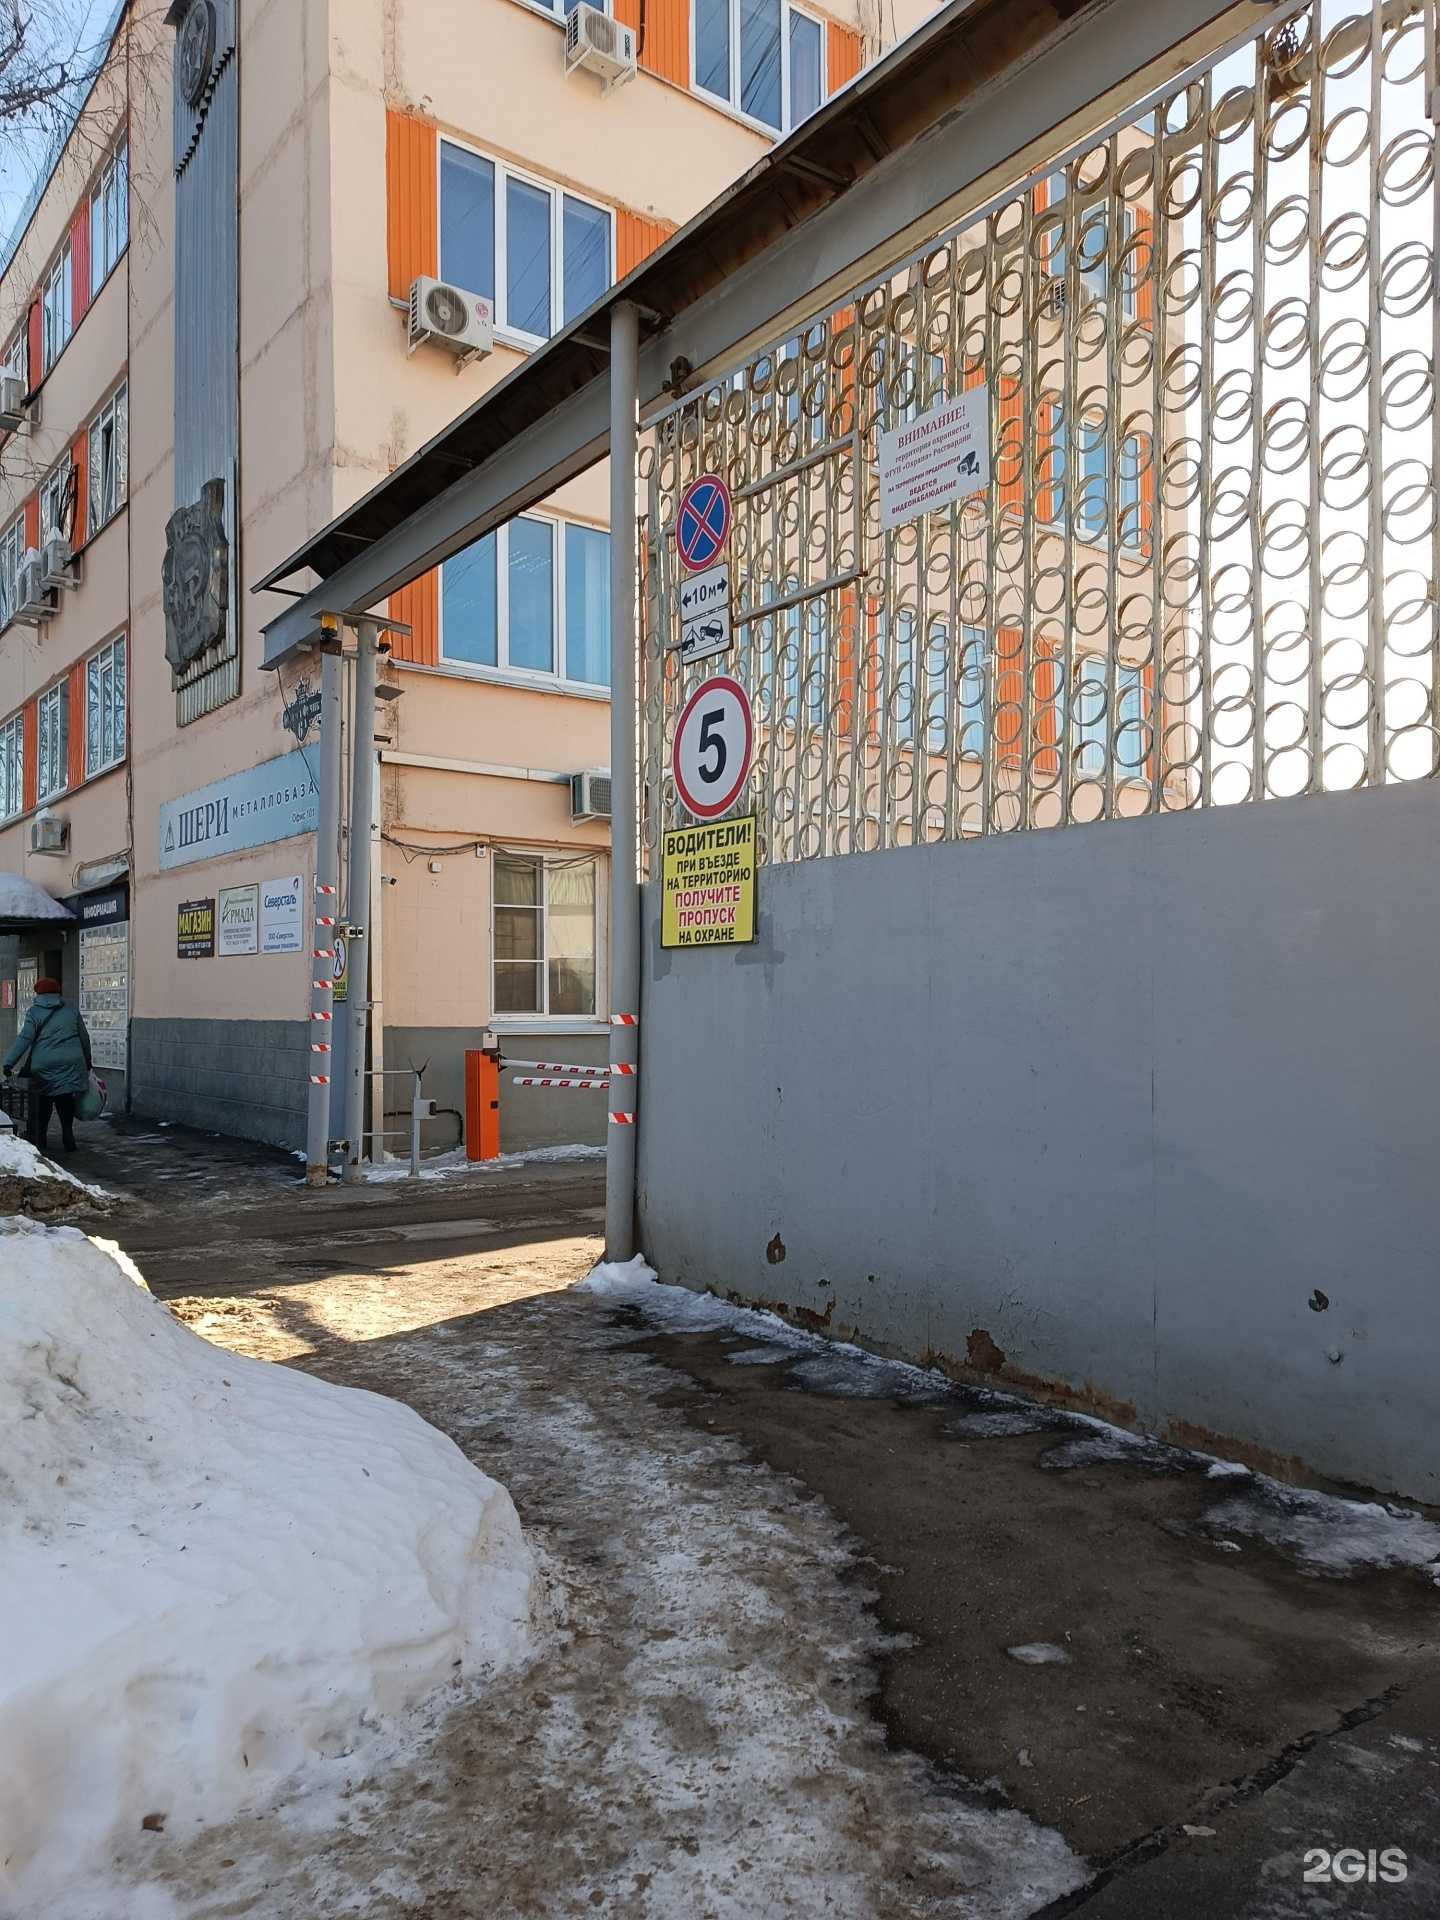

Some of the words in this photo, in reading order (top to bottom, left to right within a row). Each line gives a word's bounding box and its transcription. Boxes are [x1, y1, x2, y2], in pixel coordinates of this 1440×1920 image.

[897, 405, 966, 448] ВНИМАНИЕ!
[932, 422, 970, 446] охраняется
[884, 467, 901, 478] ФГУП
[891, 480, 957, 514] ВИДЕОНАБЛЮДЕНИЕ
[909, 478, 938, 496] ВЕДЕТСЯ
[698, 707, 727, 784] 5
[178, 797, 229, 848] ШЕРИ
[232, 781, 314, 819] МЕТАЛЛОБАЗА
[667, 823, 751, 856] ВОДИТЕЛИ!
[677, 859, 696, 874] ПРИ
[699, 852, 740, 870] ВЪЕЗДЕ
[667, 878, 679, 890] НА
[682, 867, 751, 888] ТЕРРИТОРИЮ
[265, 894, 297, 910] Северсталь
[675, 886, 740, 908] ПОЛУЧИТЕ
[179, 910, 212, 934] МАГАЗИН
[679, 907, 735, 927] ПРОПУСК
[679, 931, 691, 944] НА
[694, 927, 735, 942] ОХРАНЕ
